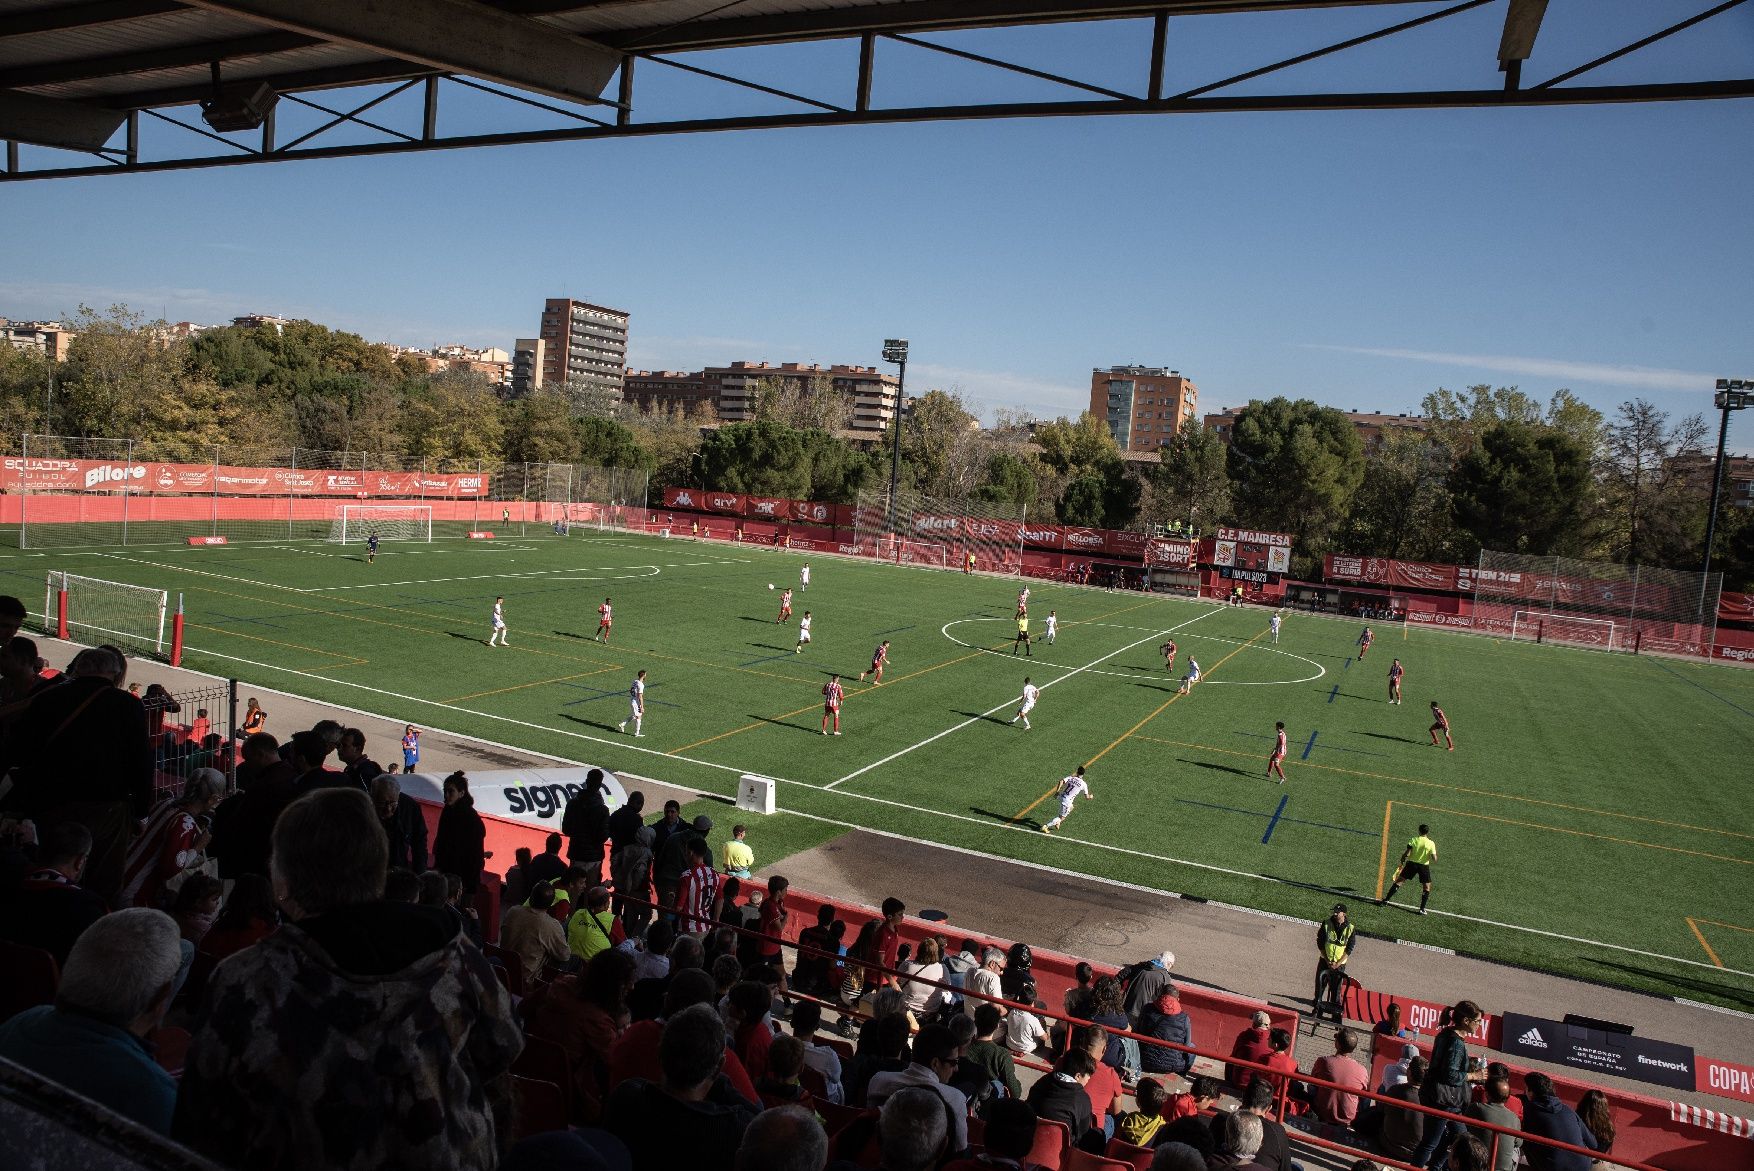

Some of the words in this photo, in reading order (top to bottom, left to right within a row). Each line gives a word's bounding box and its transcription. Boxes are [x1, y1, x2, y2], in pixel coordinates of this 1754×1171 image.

[1238, 531, 1290, 546] MANRESA
[1518, 1037, 1548, 1049] adidas
[1636, 1054, 1689, 1073] finetwork
[1709, 1064, 1751, 1095] COPA
